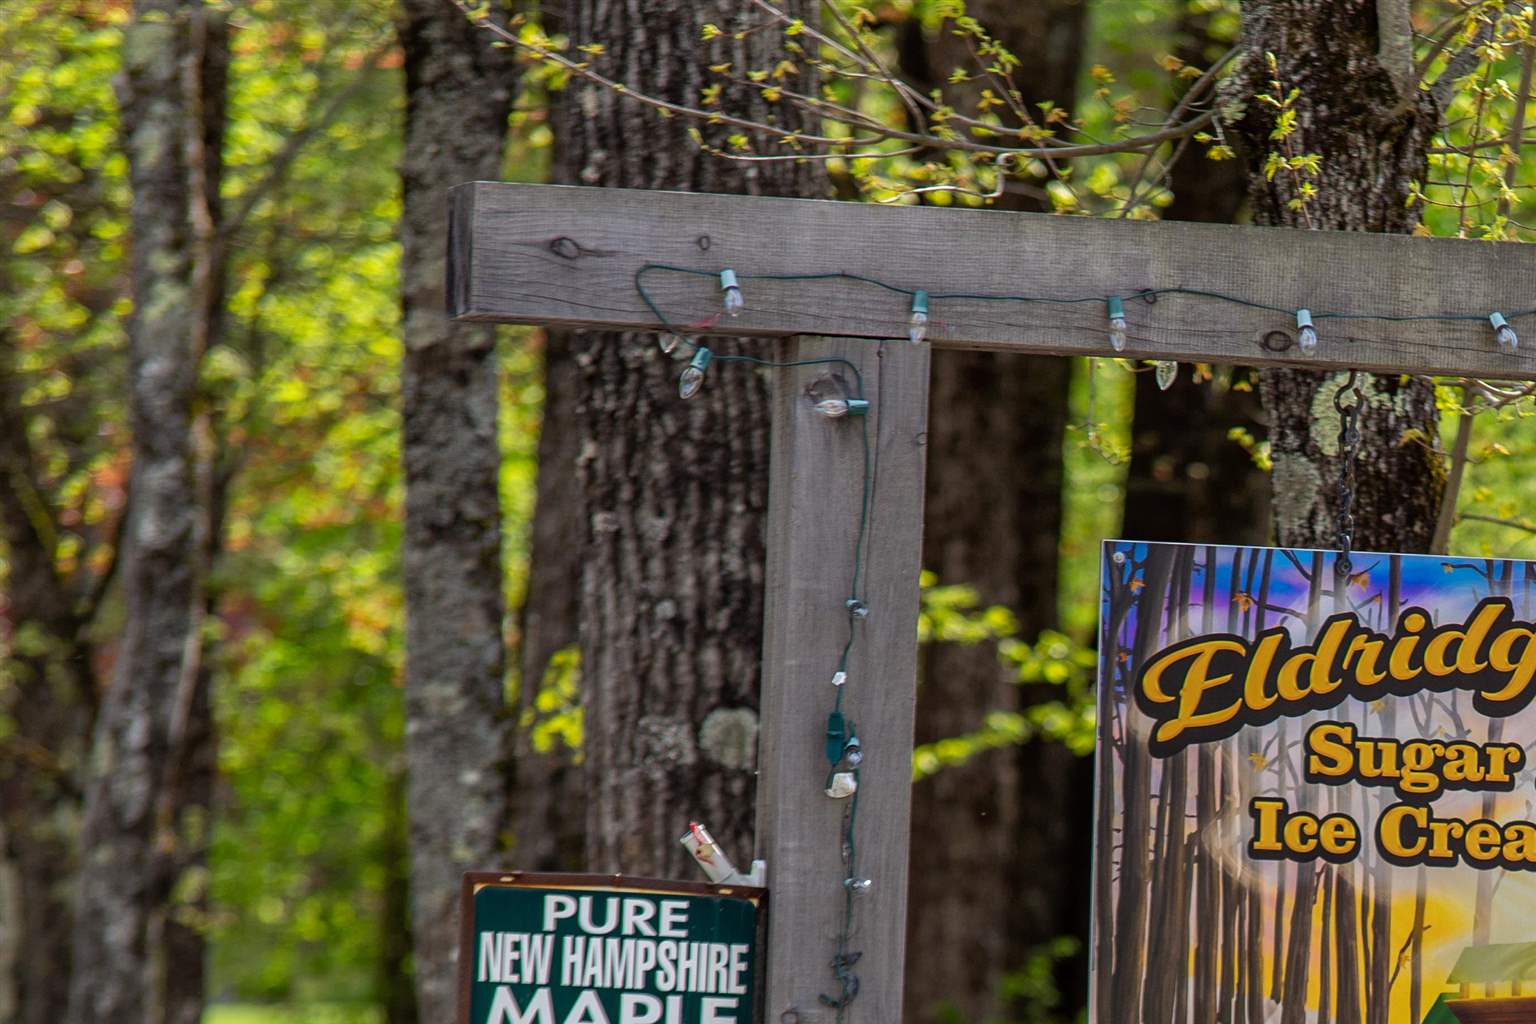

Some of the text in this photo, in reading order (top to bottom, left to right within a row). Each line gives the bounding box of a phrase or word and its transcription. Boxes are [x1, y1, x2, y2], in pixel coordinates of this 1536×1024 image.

[1308, 722, 1520, 791] Sugar
[1254, 801, 1356, 856] Ice
[543, 895, 689, 937] PURE
[478, 931, 749, 994] NEW HAMPSHIRE
